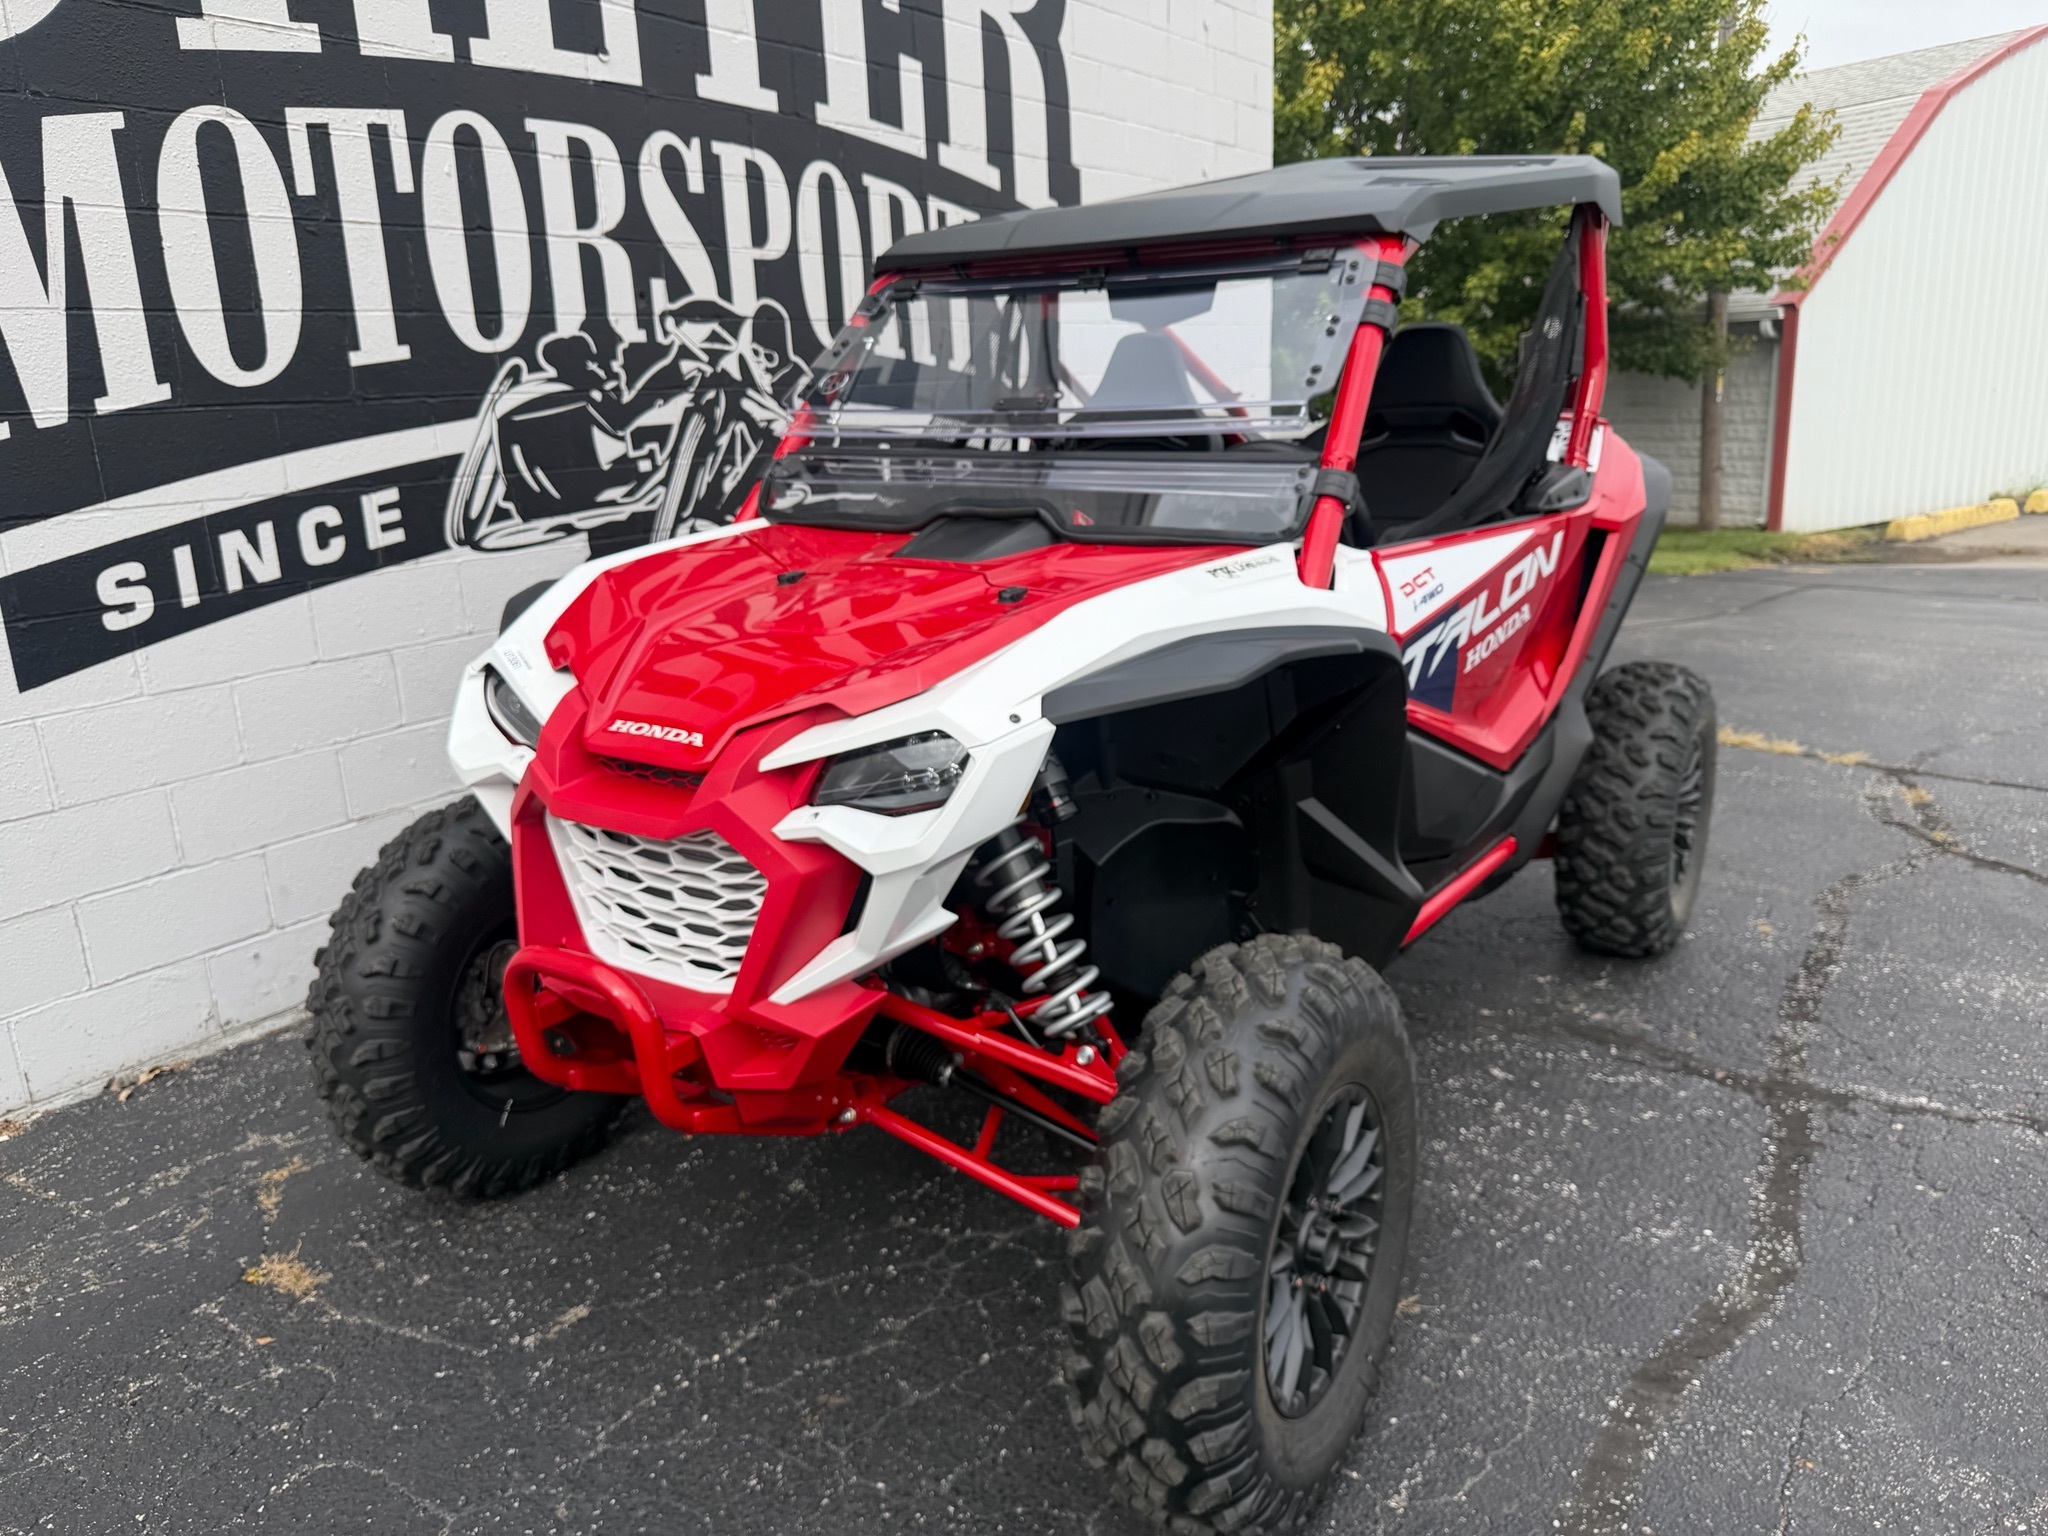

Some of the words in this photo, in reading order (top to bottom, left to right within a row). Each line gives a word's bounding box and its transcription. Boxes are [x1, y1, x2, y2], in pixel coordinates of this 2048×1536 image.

[96, 486, 406, 632] SINCE
[1400, 566, 1436, 598] DCT
[1402, 529, 1565, 692] TALON
[1463, 602, 1532, 675] HONDA
[607, 719, 704, 748] HONDA
